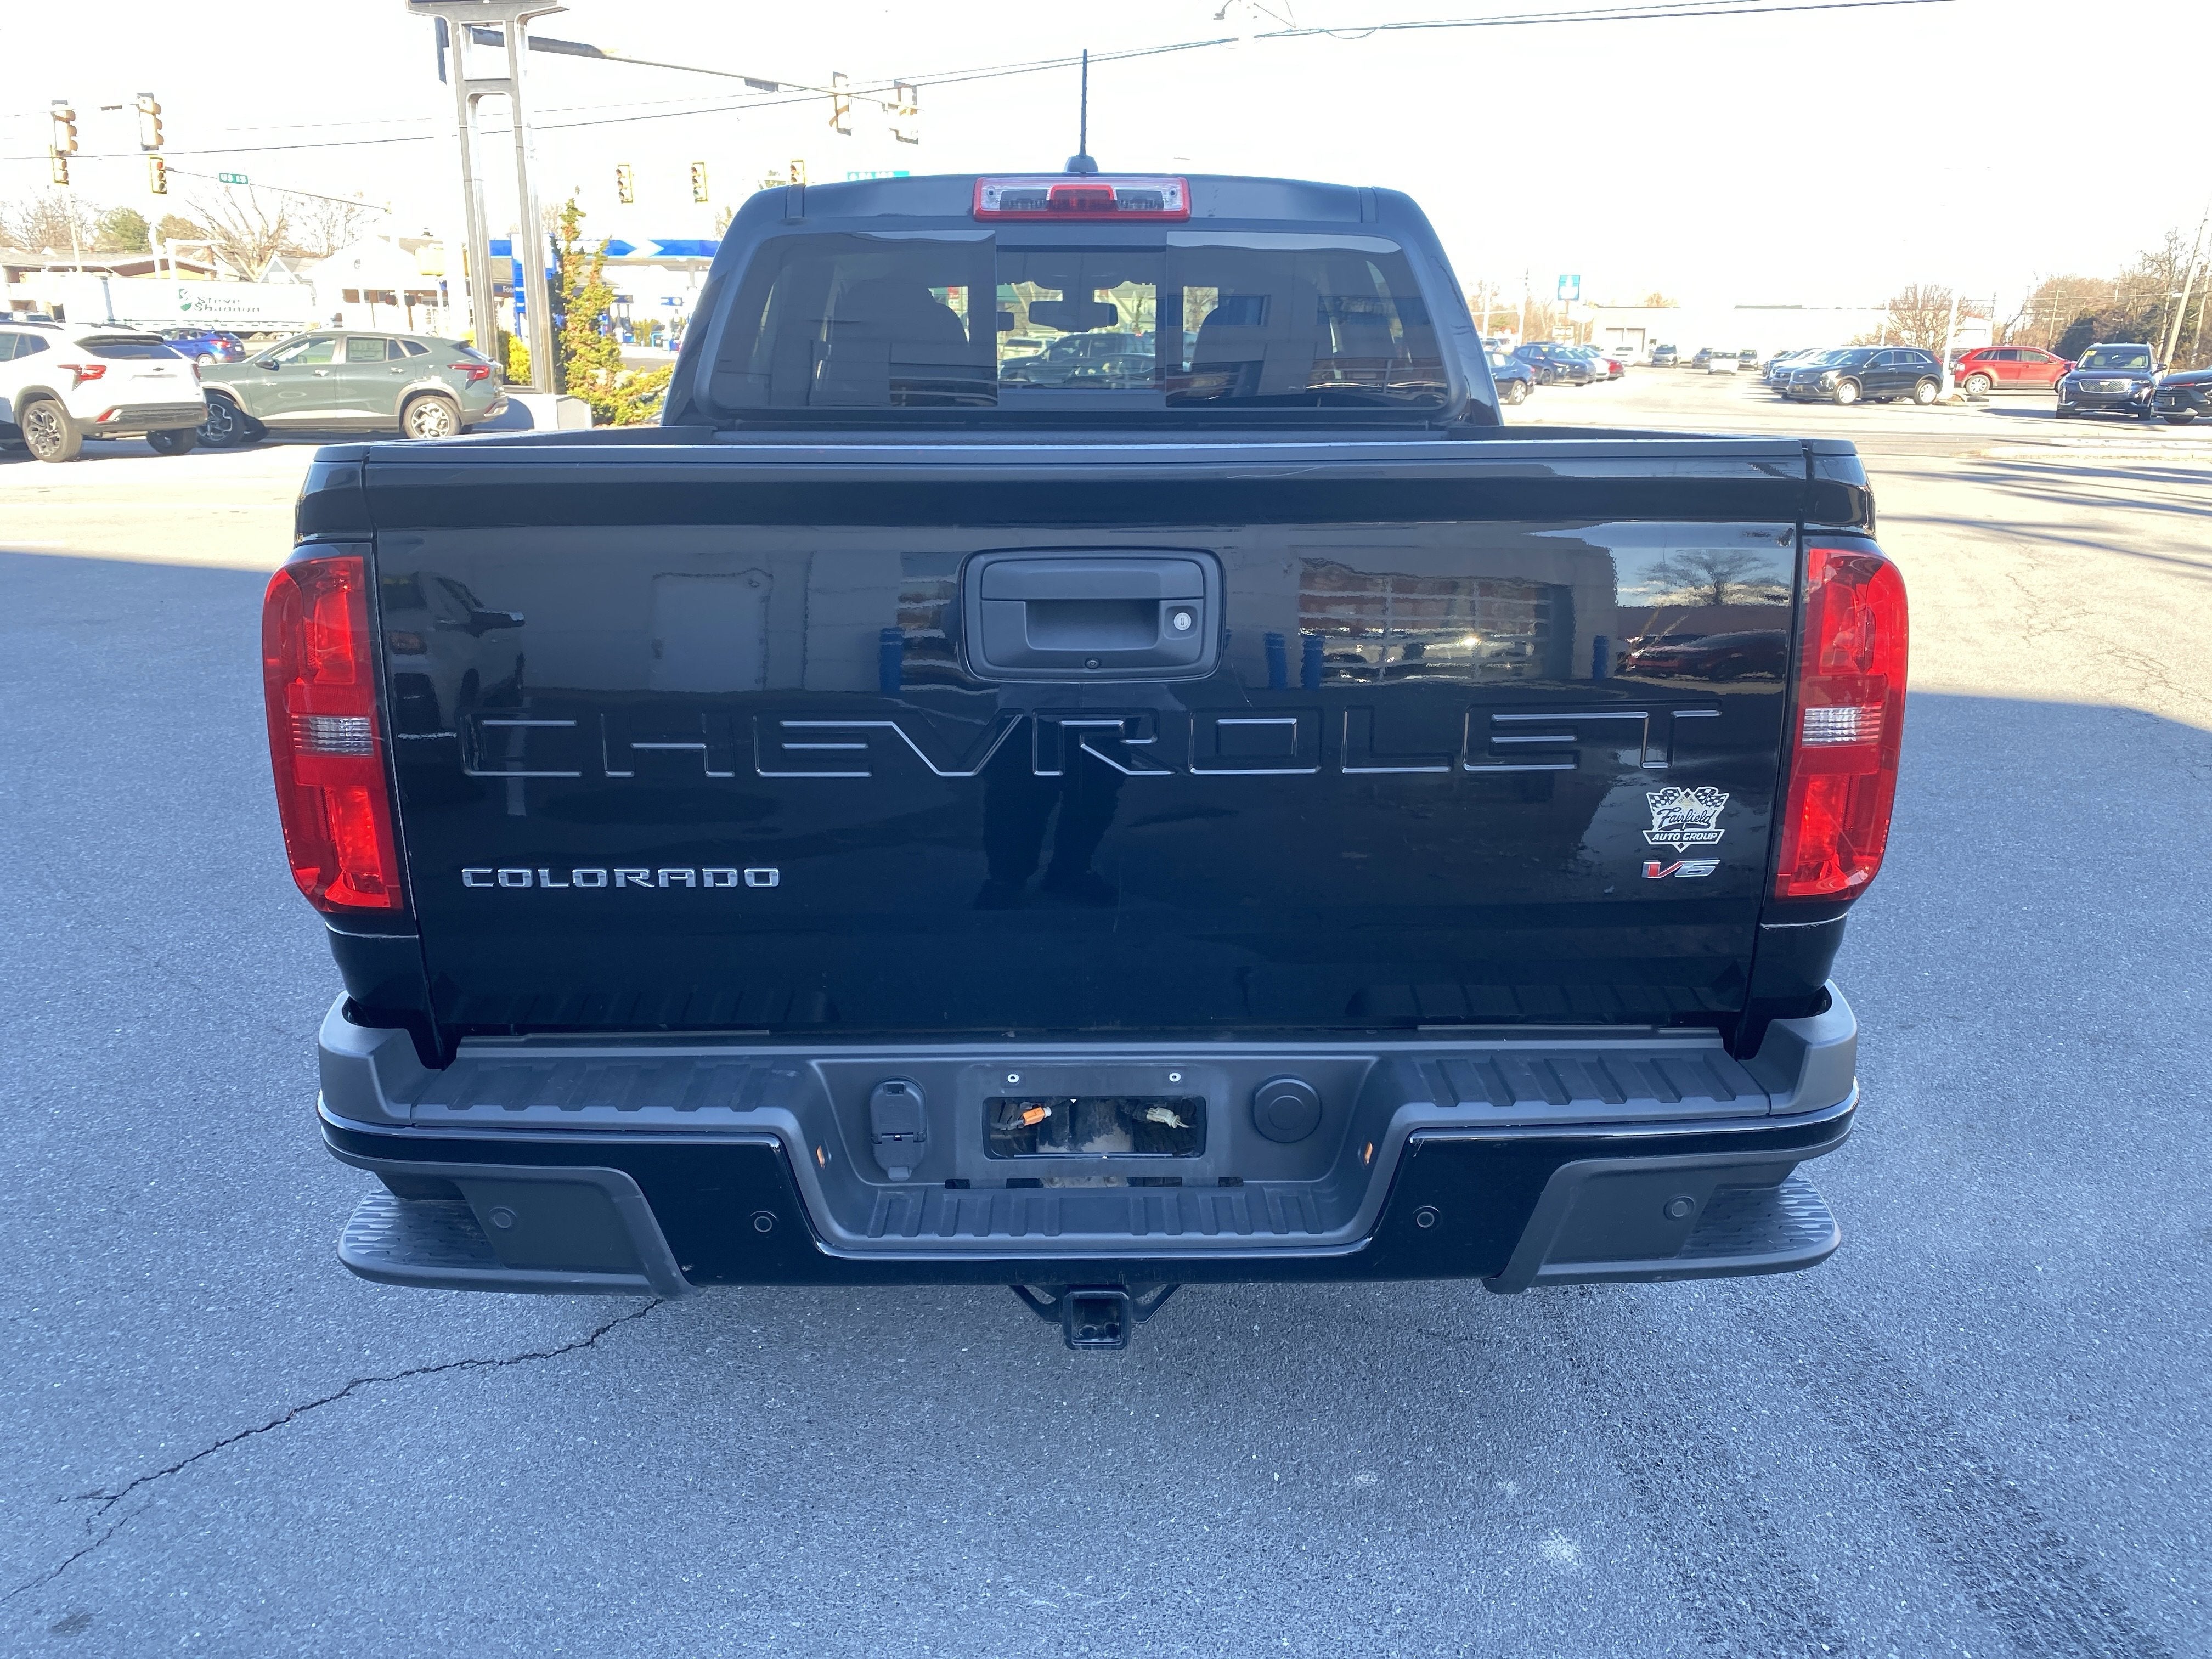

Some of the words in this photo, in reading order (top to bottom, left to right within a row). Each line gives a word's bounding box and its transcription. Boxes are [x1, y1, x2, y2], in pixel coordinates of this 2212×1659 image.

[221, 173, 234, 182] US
[235, 175, 247, 183] 15
[456, 699, 1723, 778] CHEVROLET
[1656, 806, 1717, 831] Fairfield
[1651, 833, 1681, 841] AUTO
[1682, 832, 1718, 840] GROUP
[461, 868, 780, 888] COLORADO
[1641, 859, 1721, 878] V6
